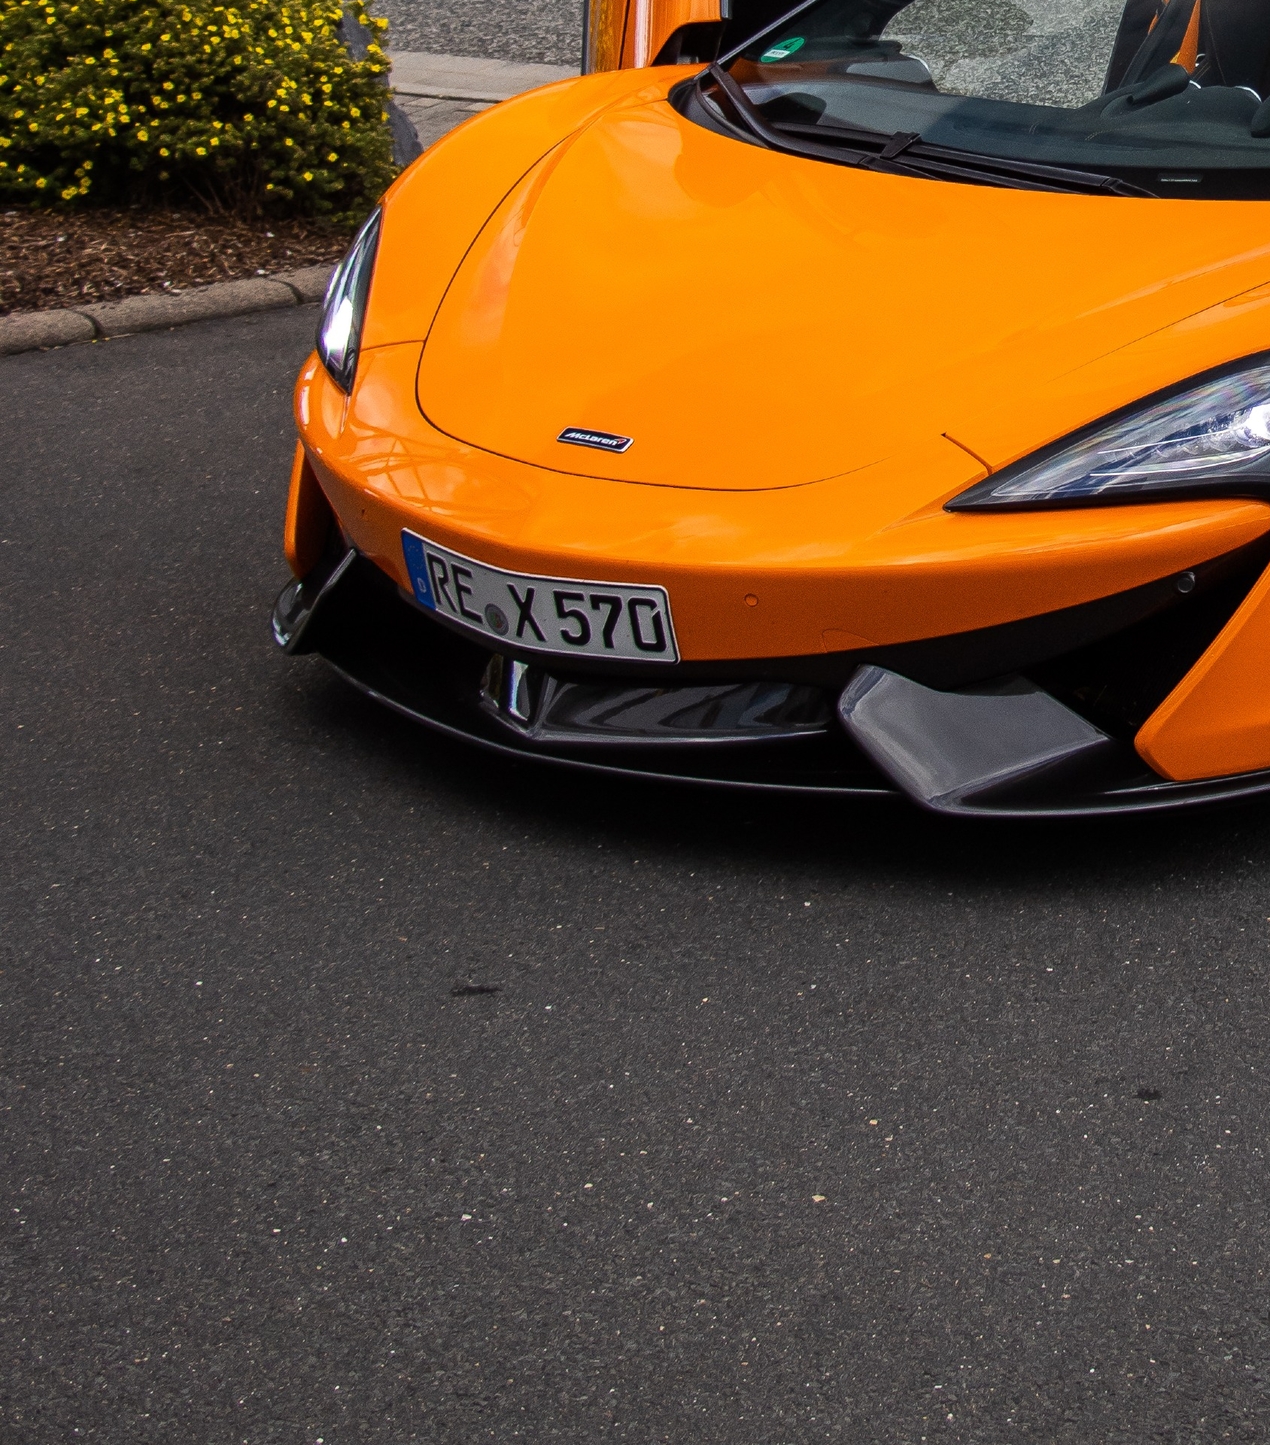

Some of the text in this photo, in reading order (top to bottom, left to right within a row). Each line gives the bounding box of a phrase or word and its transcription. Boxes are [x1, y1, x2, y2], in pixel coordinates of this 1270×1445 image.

[564, 431, 618, 446] McLaren
[426, 551, 668, 653] RE X 570
